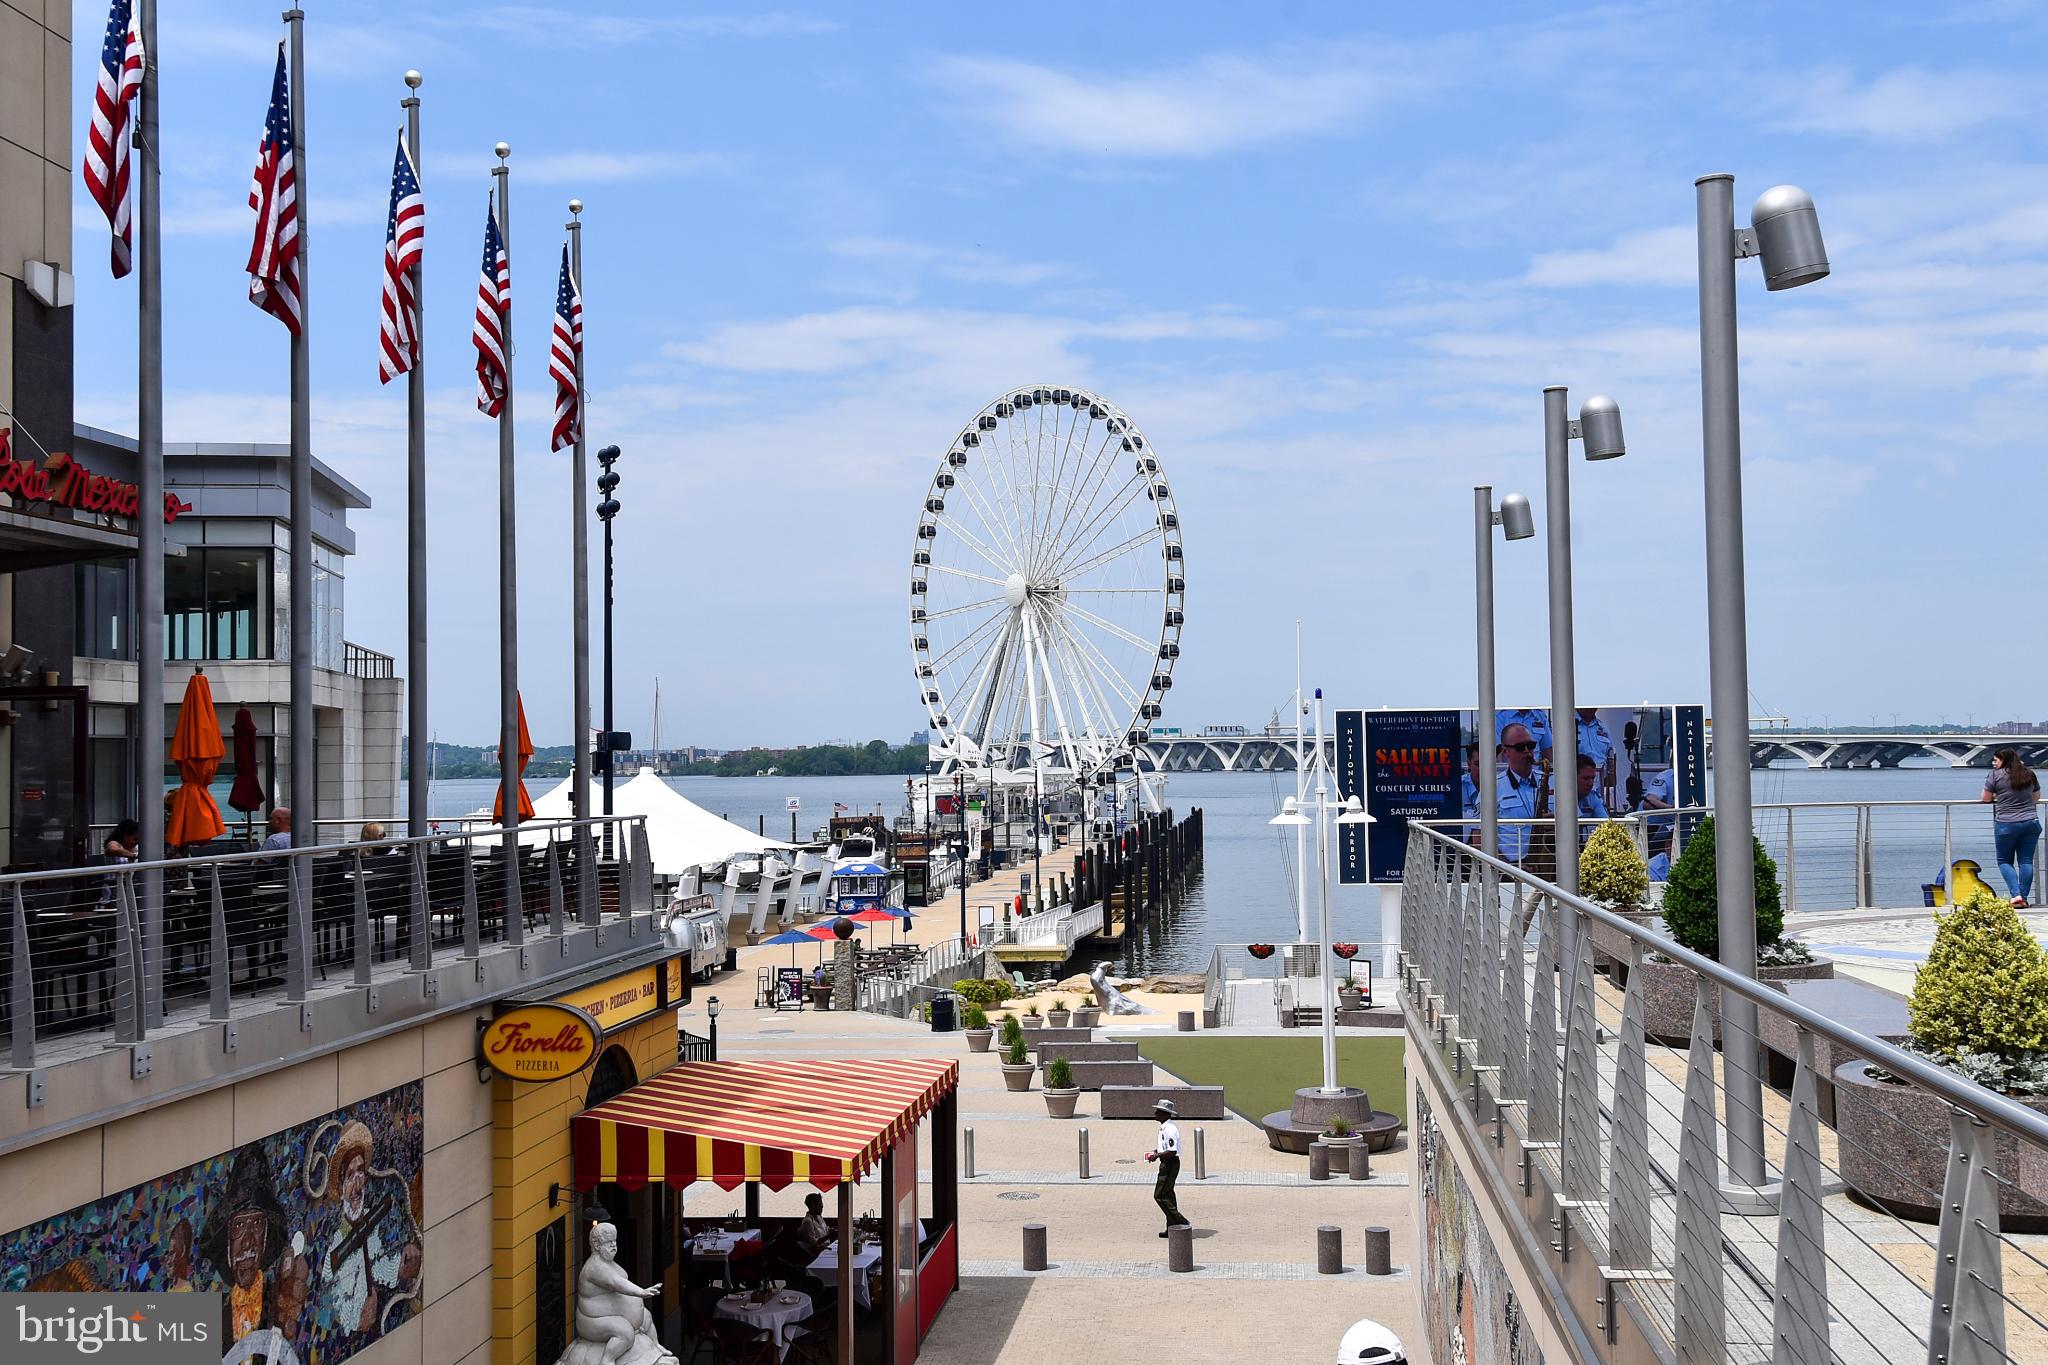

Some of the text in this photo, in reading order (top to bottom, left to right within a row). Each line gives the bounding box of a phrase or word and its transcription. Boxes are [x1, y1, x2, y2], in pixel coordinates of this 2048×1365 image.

[1346, 728, 1354, 793] NATIONAL
[1375, 747, 1451, 765] SALUTE
[1686, 721, 1695, 786] NATIONAL
[1377, 764, 1452, 778] the SUNSET
[1375, 783, 1451, 793] CONCERT SERIES
[1390, 807, 1438, 816] SATURDAYS
[1348, 822, 1356, 869] HARBOR
[609, 988, 638, 1010] PIZZERIA
[642, 981, 655, 998] BAR
[491, 1022, 586, 1054] Fiorella
[515, 1060, 560, 1072] PIZZERIA
